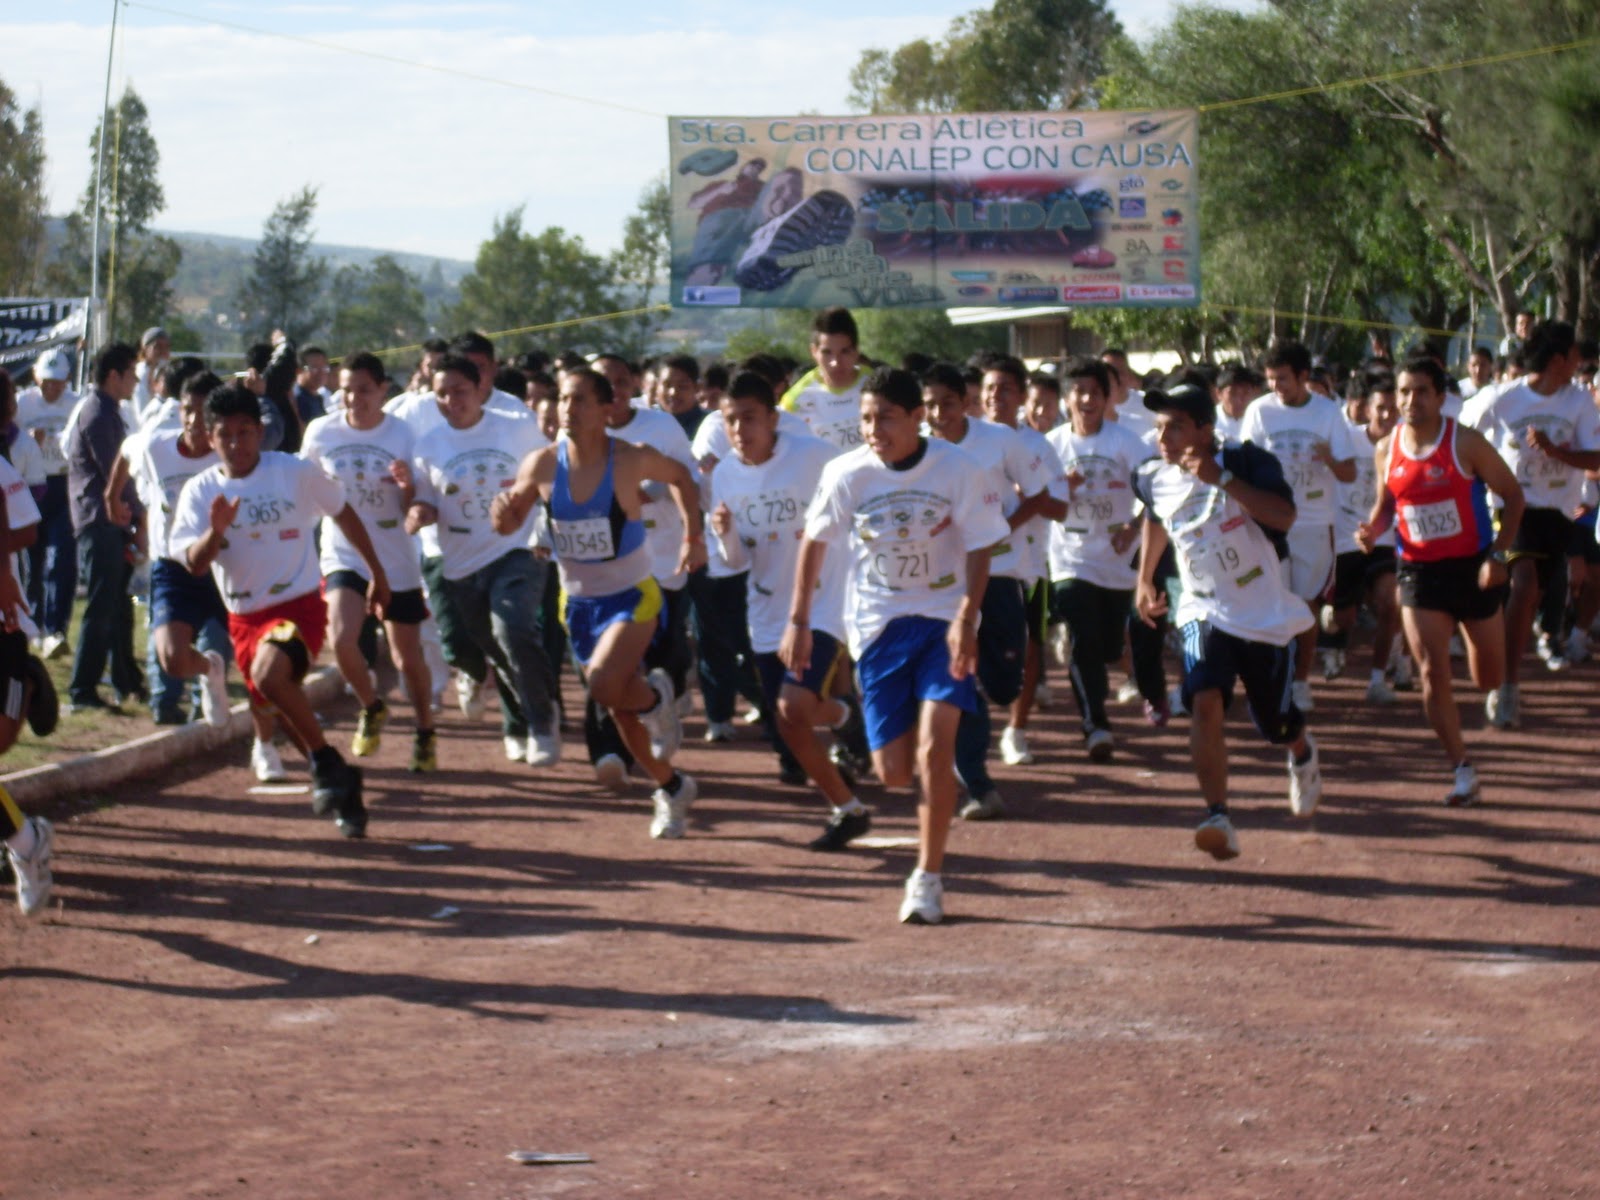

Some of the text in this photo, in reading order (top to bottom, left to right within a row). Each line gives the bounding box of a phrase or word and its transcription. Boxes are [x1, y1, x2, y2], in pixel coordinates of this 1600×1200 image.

[680, 121, 756, 144] 5ta.
[768, 120, 921, 142] Carrera
[807, 143, 1192, 171] CONALEP CON CAUSA
[876, 200, 1091, 231] SALIDA
[247, 501, 280, 525] 965
[462, 501, 473, 520] C
[746, 498, 797, 526] C 729
[875, 551, 929, 579] C 721
[1215, 547, 1241, 573] 19
